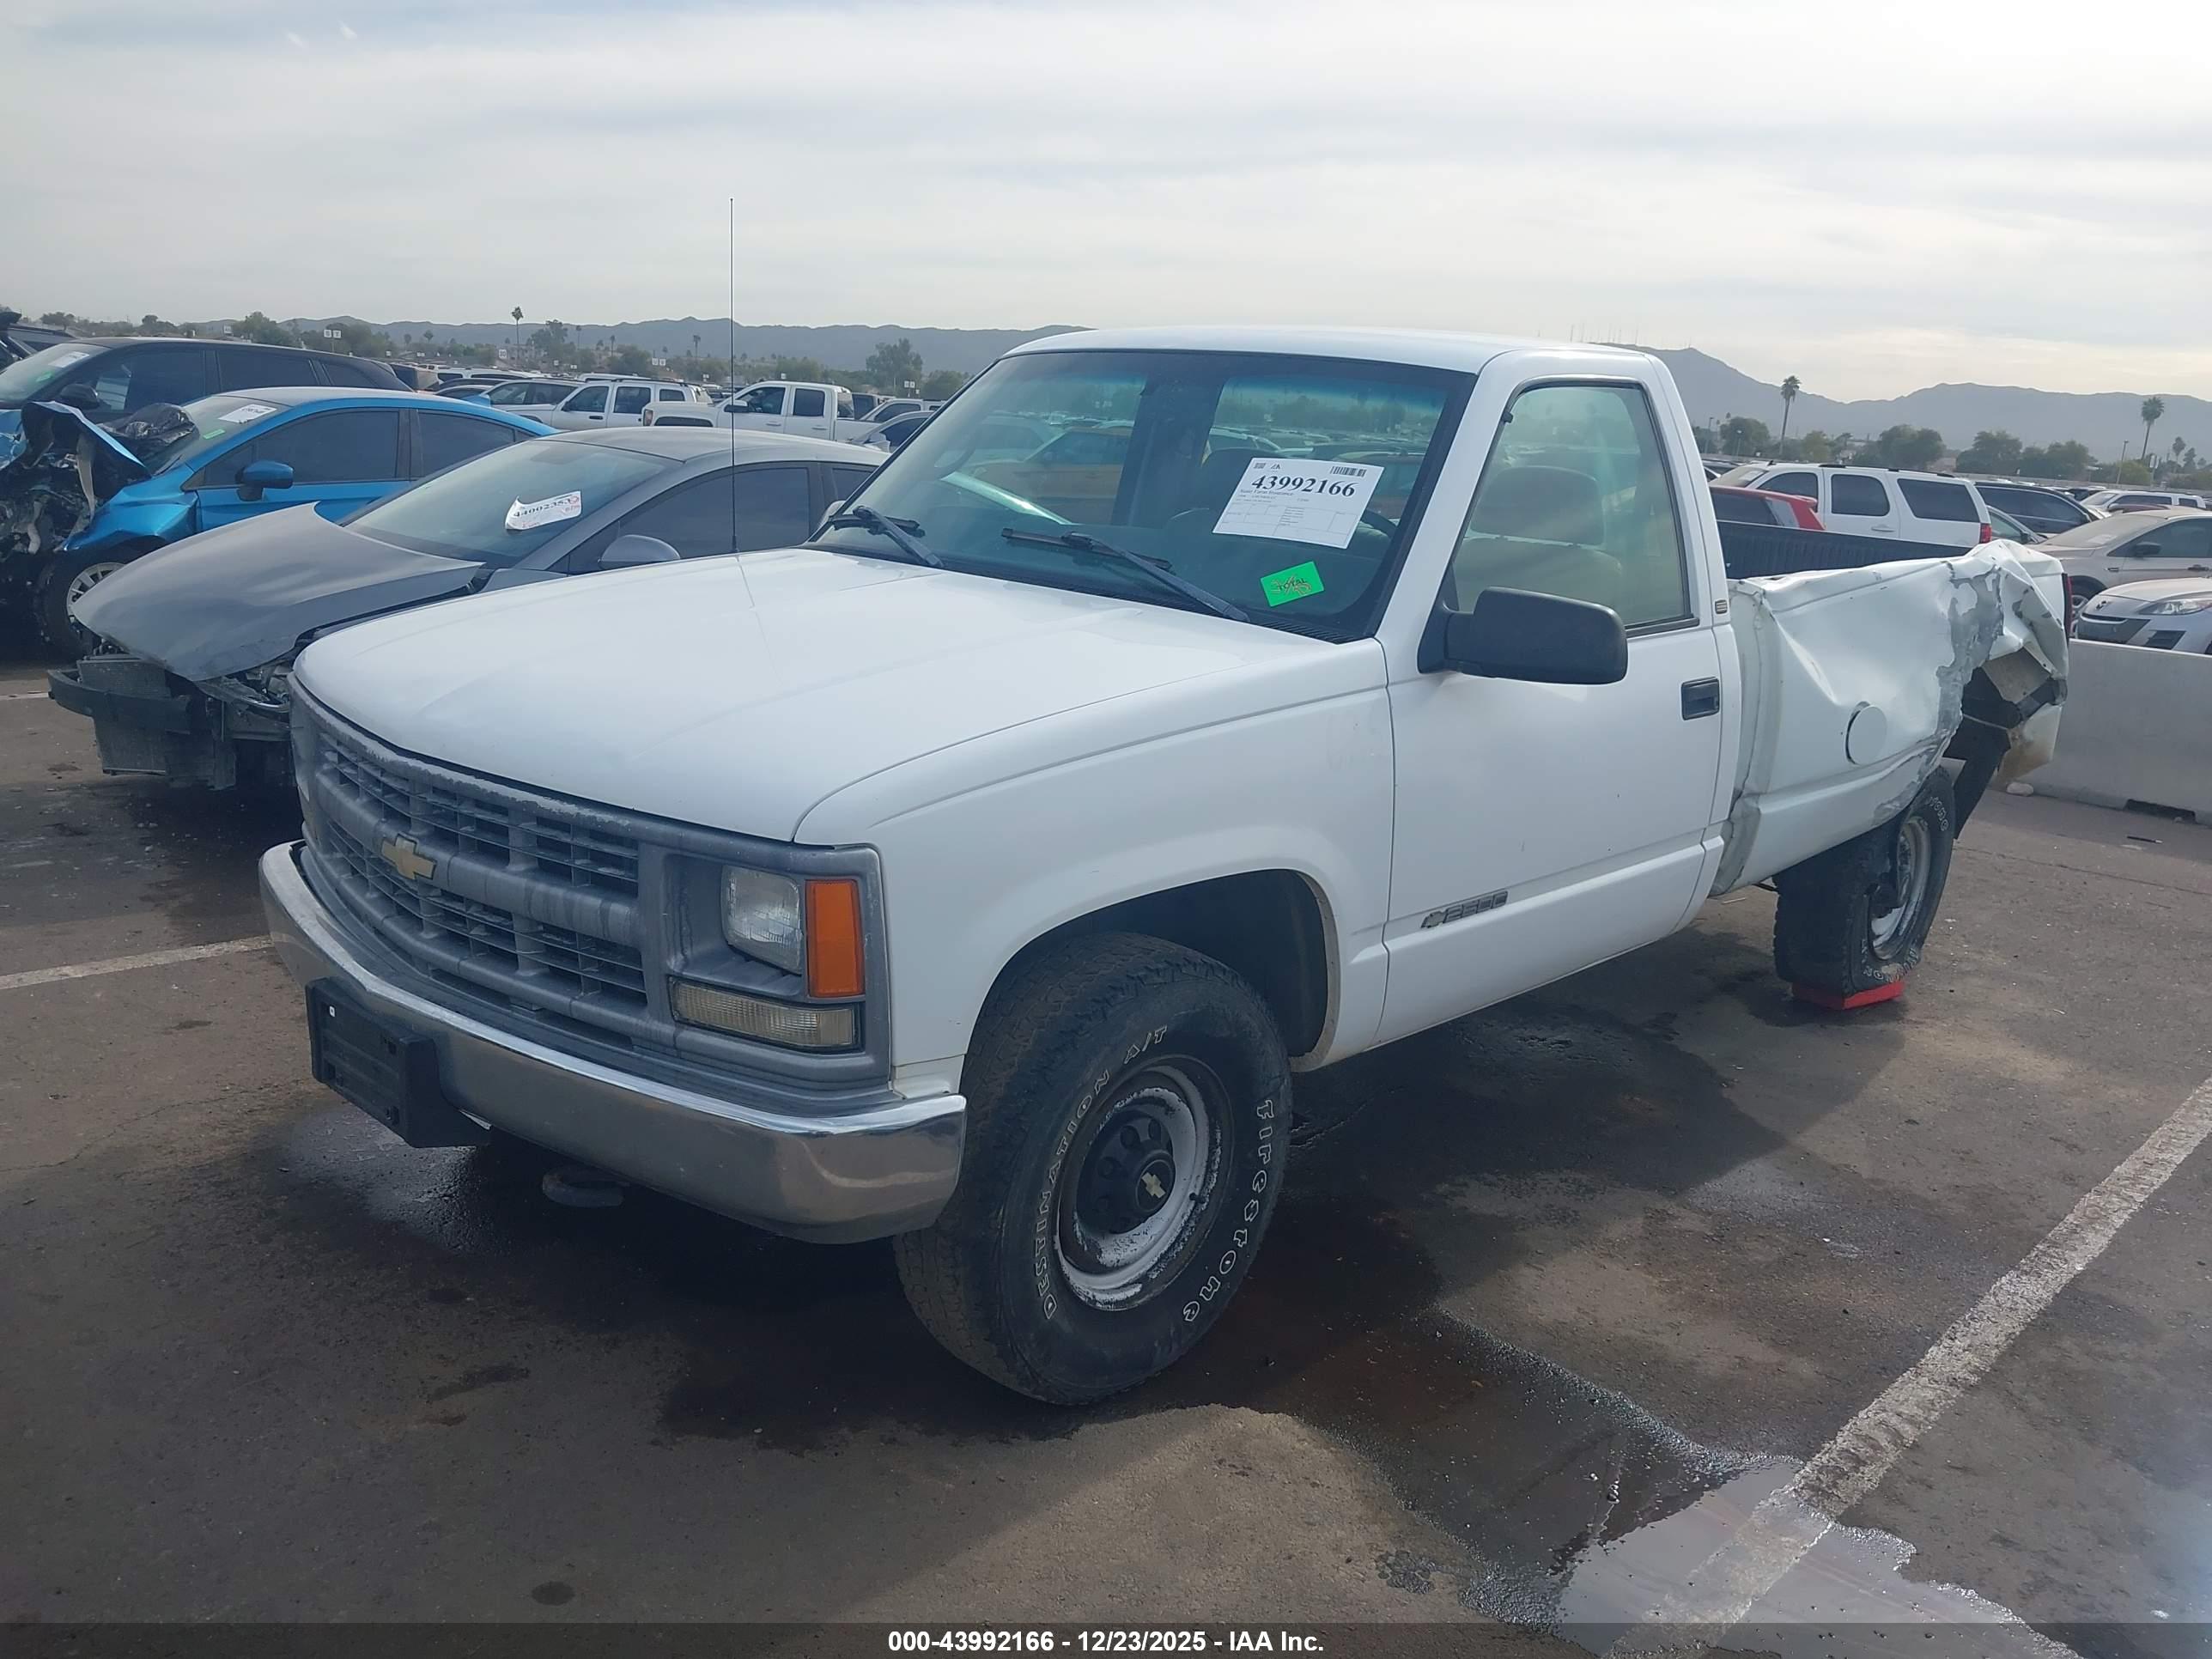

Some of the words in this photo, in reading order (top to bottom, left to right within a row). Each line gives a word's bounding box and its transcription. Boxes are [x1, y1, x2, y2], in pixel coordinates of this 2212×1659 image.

[1251, 475, 1359, 497] 43992166
[1035, 1070, 1110, 1320] DESTINATION
[1123, 1025, 1168, 1064] A/T
